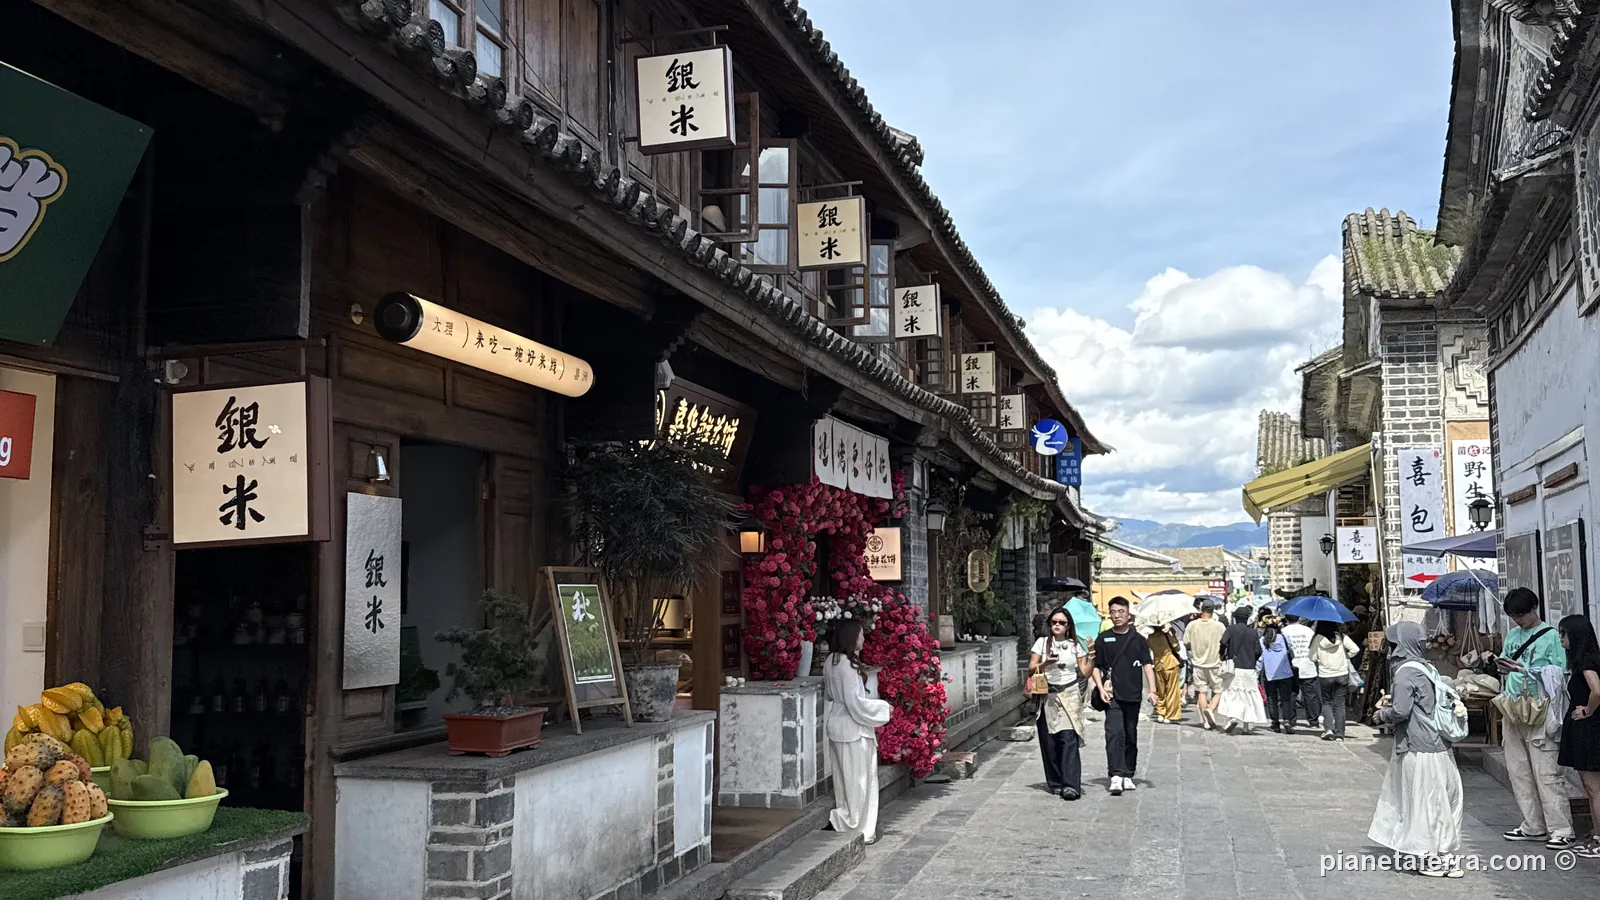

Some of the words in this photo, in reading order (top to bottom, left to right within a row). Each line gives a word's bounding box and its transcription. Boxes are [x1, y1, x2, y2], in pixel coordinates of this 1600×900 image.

[432, 316, 454, 337] 大理
[215, 395, 270, 531] 銀米
[1406, 455, 1434, 533] 喜包
[1349, 529, 1365, 561] 喜包
[364, 549, 388, 634] 銀米
